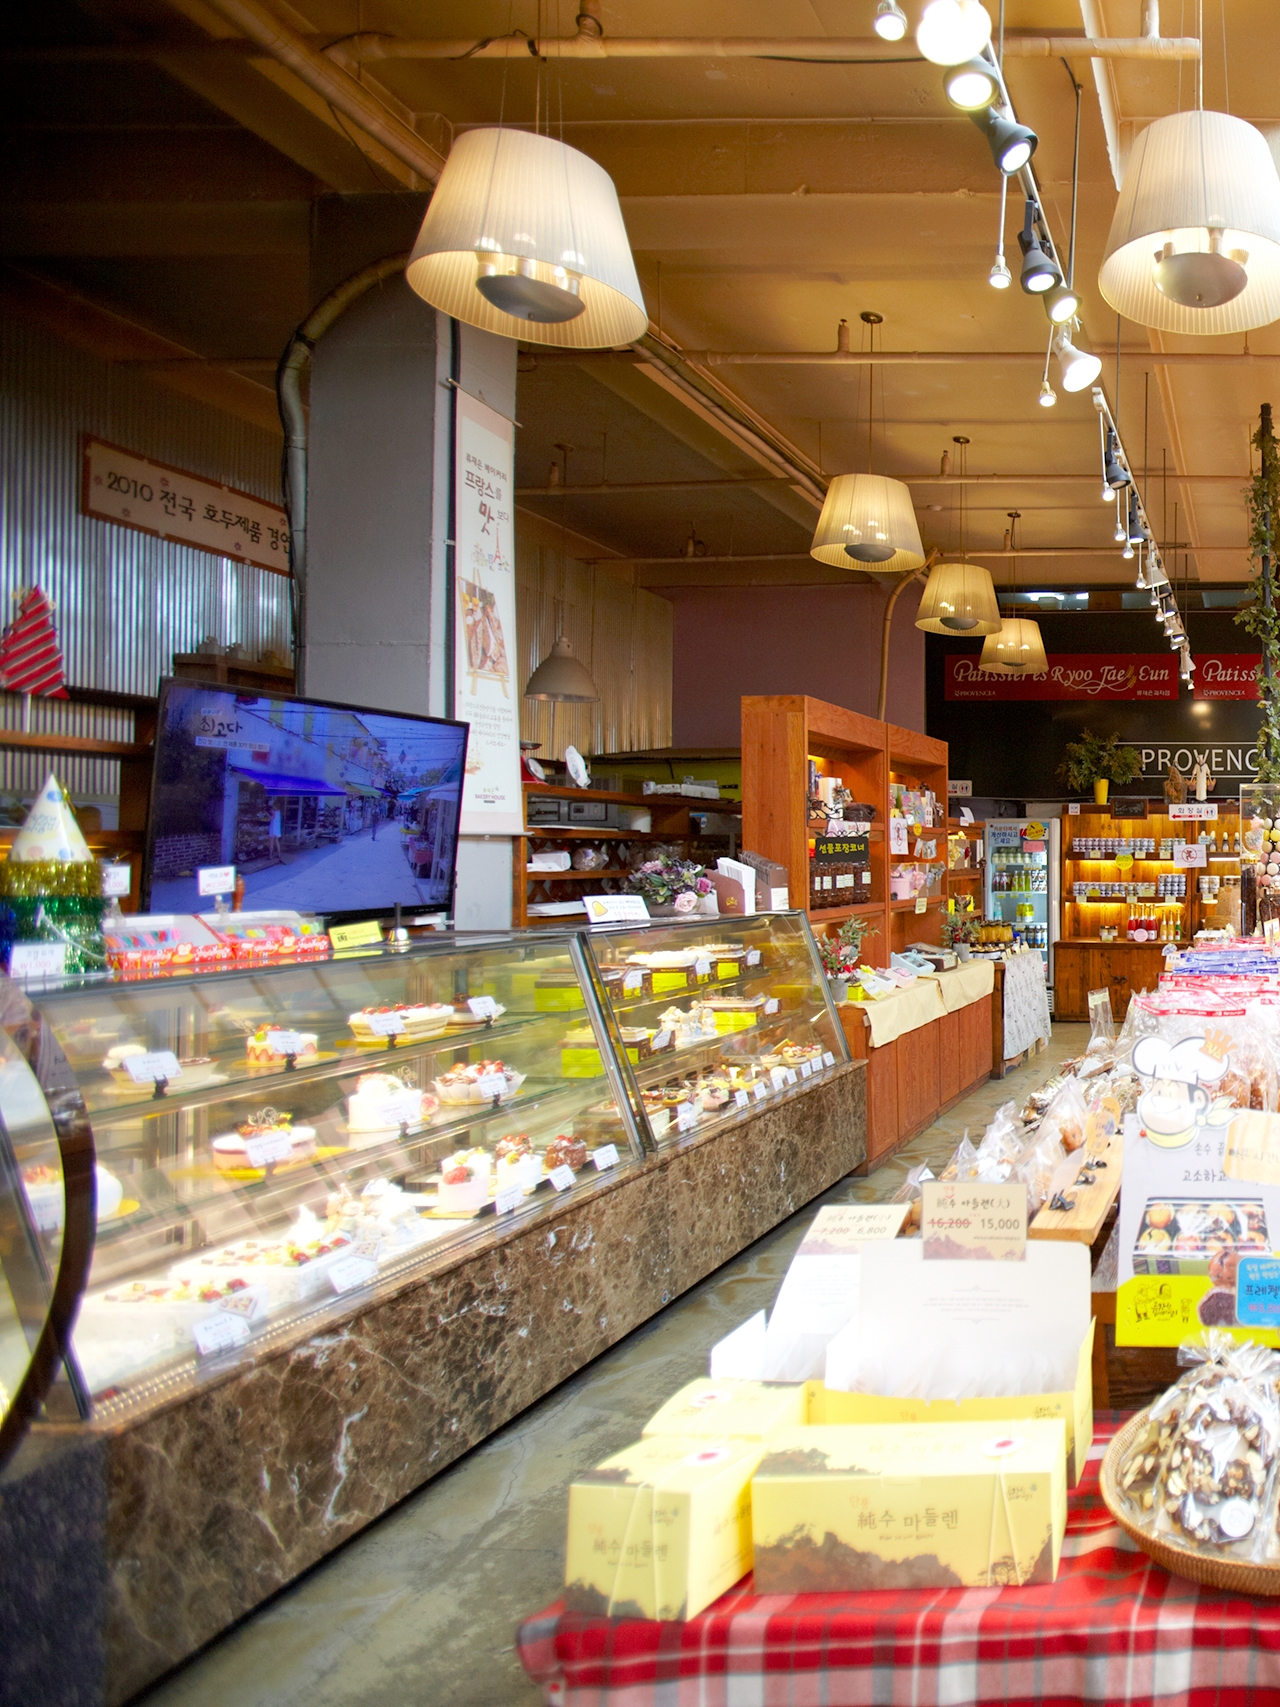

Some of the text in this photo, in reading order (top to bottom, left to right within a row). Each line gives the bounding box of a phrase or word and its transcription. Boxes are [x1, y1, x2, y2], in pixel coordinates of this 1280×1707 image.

[107, 471, 153, 502] 2010
[160, 489, 196, 521] 전국
[203, 504, 263, 544] 호두제품
[1050, 665, 1094, 688] Ryoo
[1138, 665, 1170, 682] Eun
[199, 716, 243, 737] 최고다
[1142, 749, 1265, 772] PROVENC
[819, 843, 865, 854] 선물포장코너
[1182, 1169, 1227, 1183] 고소하고
[857, 1226, 887, 1235] 6,800
[930, 1218, 1020, 1230] 16,200 15,000
[903, 1508, 959, 1531] 마들렌
